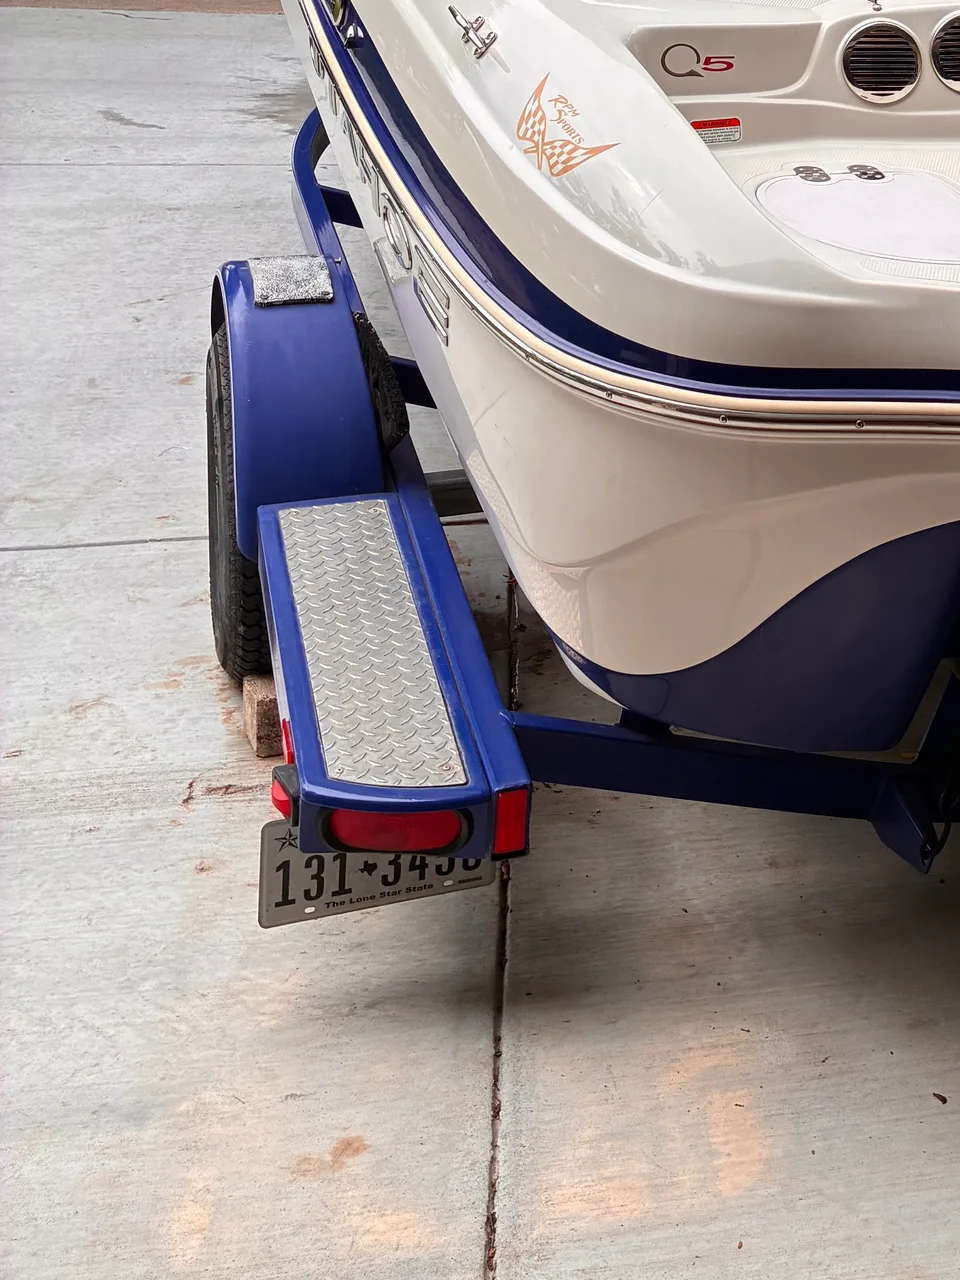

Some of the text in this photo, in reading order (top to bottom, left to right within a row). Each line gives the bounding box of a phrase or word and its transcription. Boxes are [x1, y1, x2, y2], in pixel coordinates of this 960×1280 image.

[660, 43, 735, 78] Q5
[548, 94, 580, 117] RPM
[274, 852, 482, 908] 131 34
[325, 883, 434, 908] The Lone Star State
